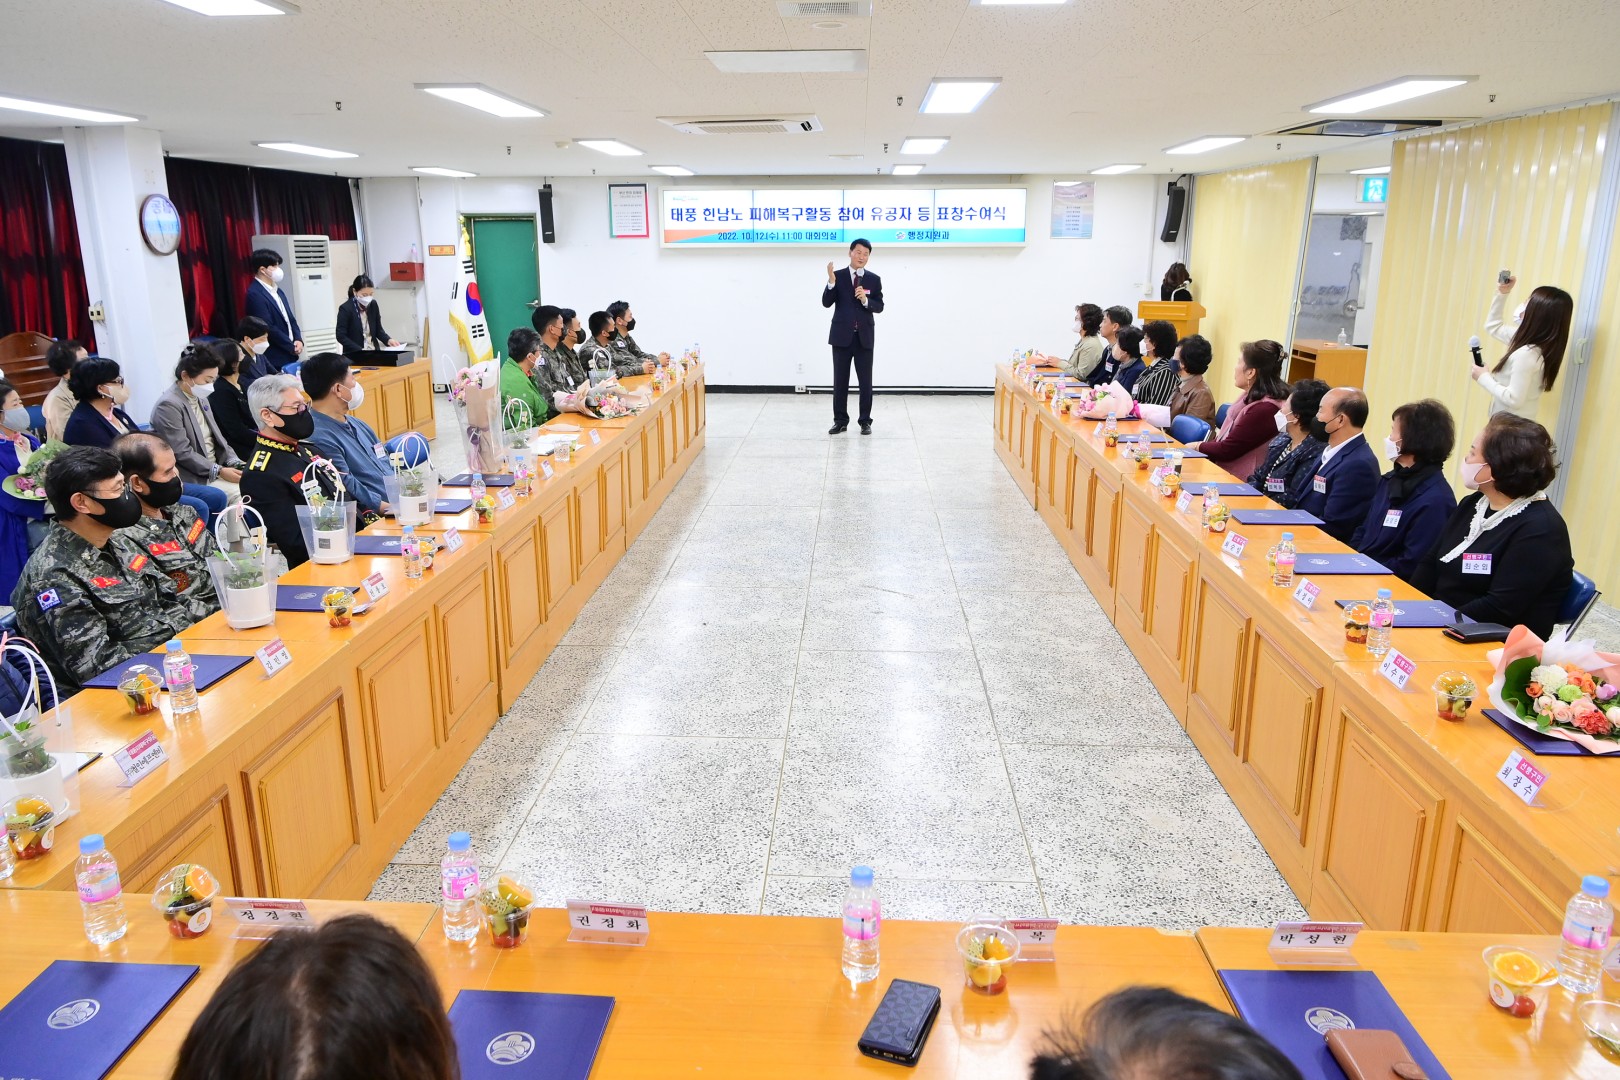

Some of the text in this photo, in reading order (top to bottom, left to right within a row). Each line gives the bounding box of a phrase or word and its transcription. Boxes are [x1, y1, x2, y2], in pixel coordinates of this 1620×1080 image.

[671, 206, 1006, 222] 태풍 힌남노 피해복구활동 참여 유공자 등 표창수여식
[717, 232, 739, 240] 2022.
[782, 232, 803, 240] 11:00
[805, 231, 837, 241] 대회의실
[907, 230, 950, 240] 행정지원과
[1519, 761, 1544, 784] 선행구민
[1501, 766, 1533, 797] 최장수
